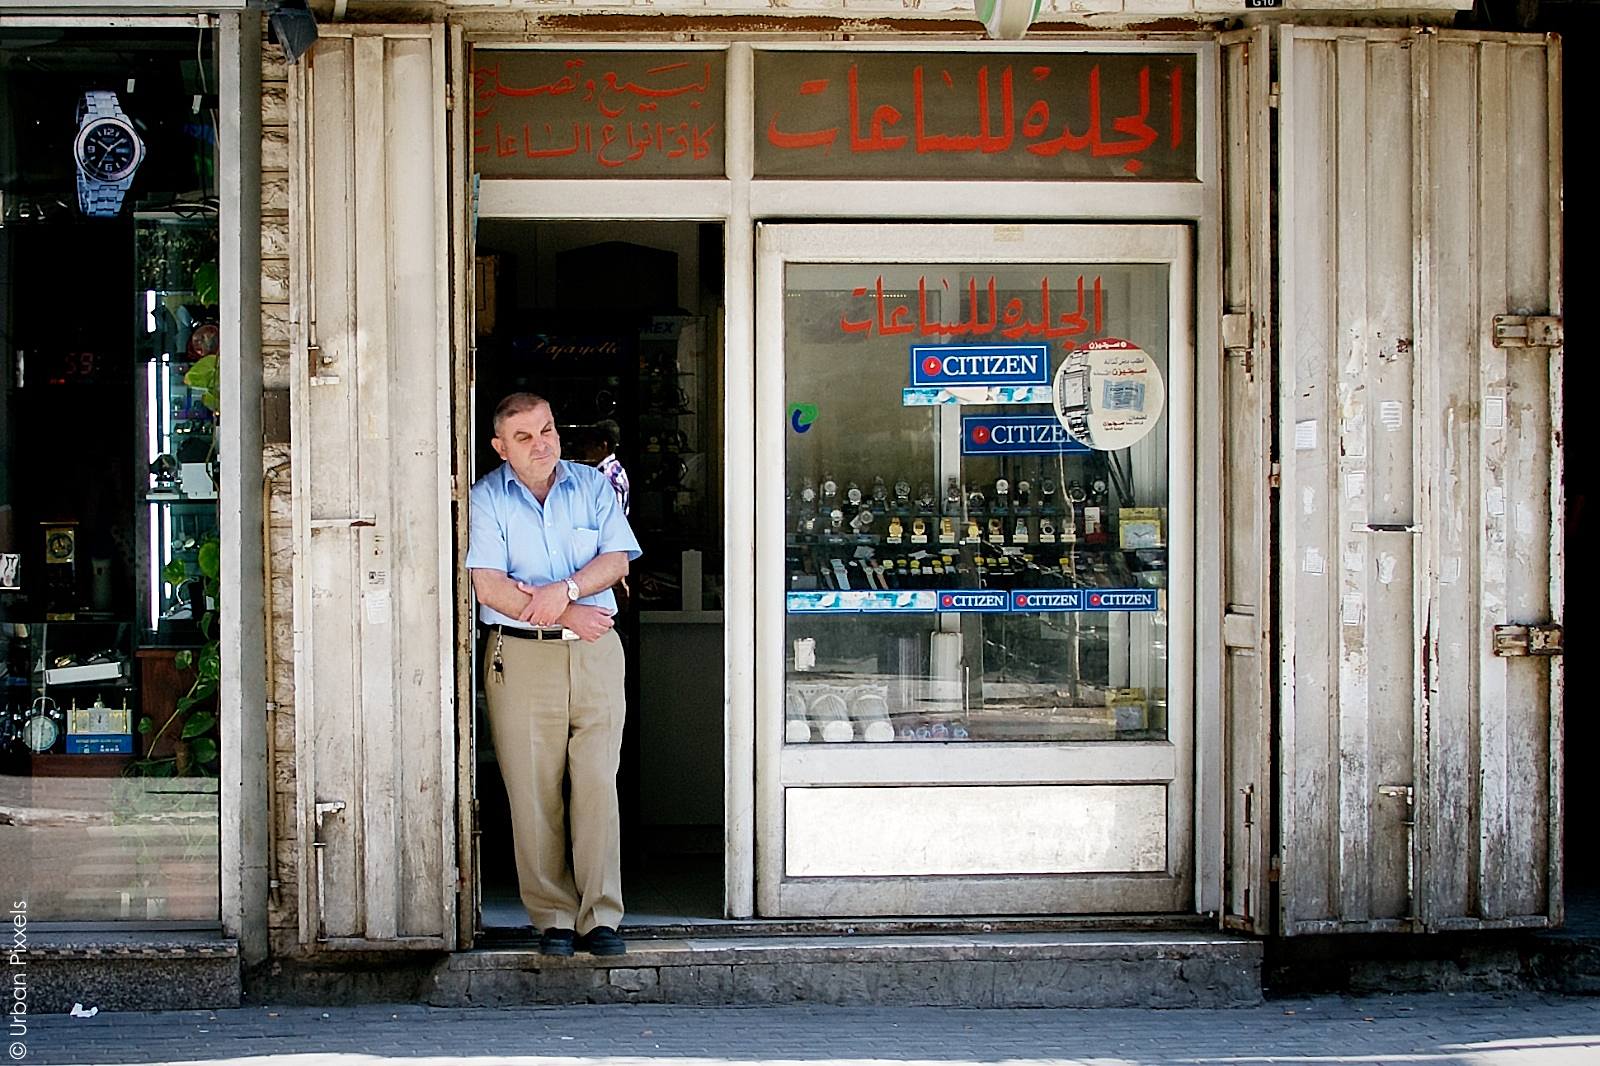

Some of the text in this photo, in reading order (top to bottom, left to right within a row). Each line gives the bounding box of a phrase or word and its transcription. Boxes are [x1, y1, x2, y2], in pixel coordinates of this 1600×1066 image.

[767, 64, 1015, 156] للساعات
[839, 273, 998, 340] للساعات
[942, 355, 1038, 376] CITIZEN
[952, 595, 1004, 607] CITIZEN
[1026, 595, 1078, 607] CITIZEN
[1100, 594, 1152, 606] CITIZEN
